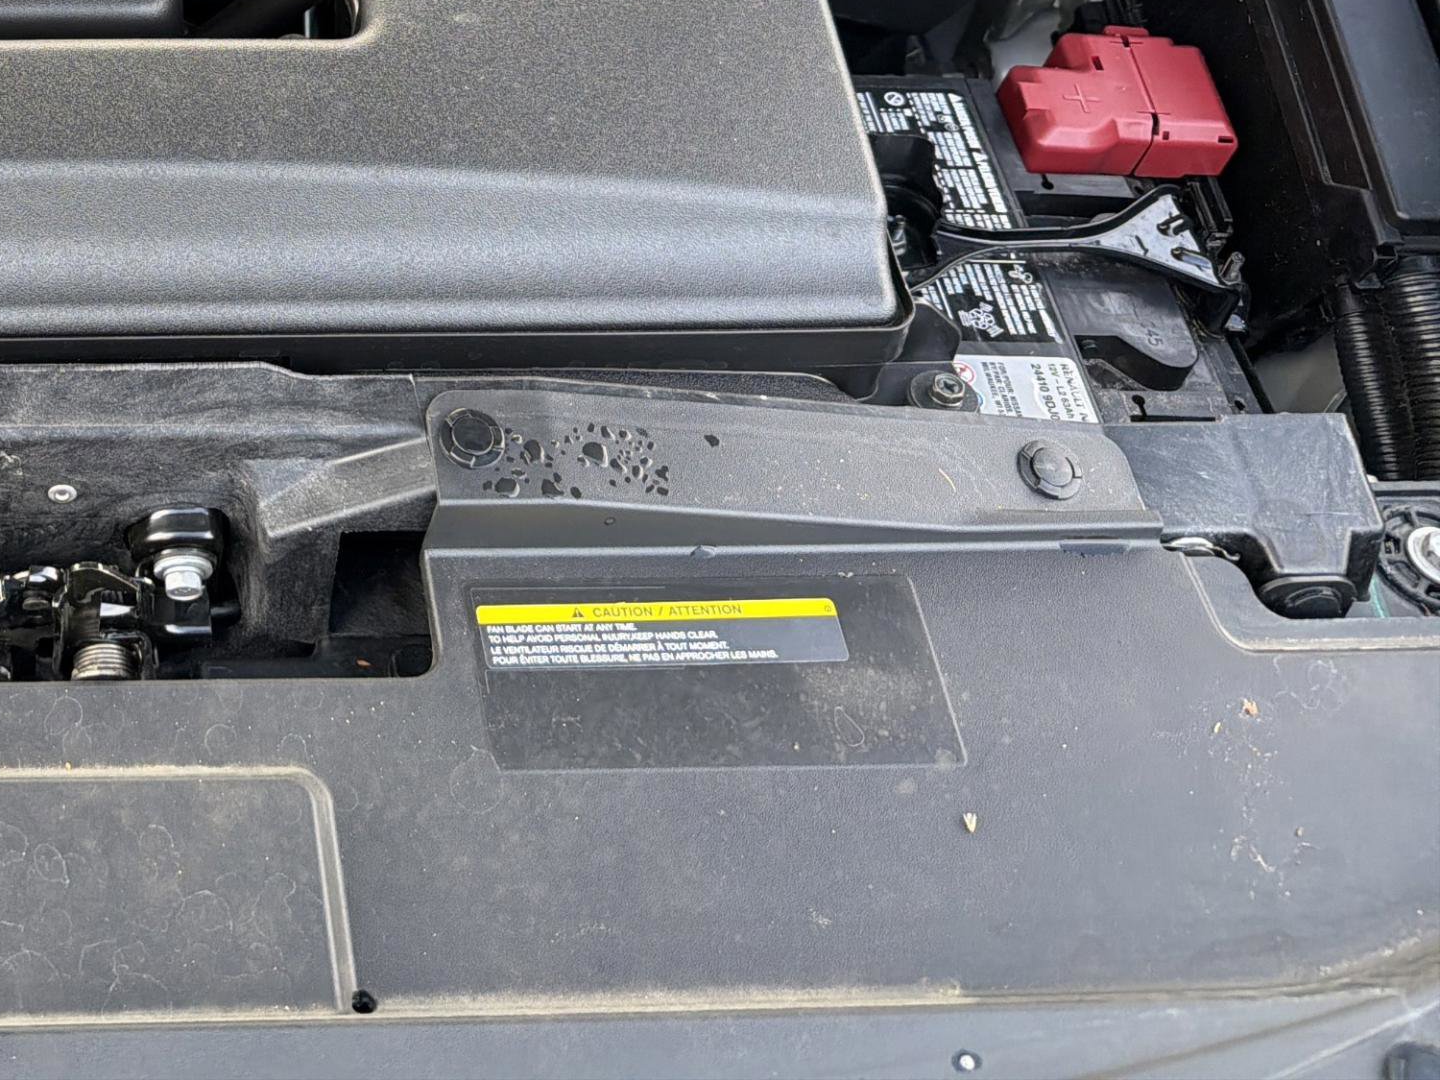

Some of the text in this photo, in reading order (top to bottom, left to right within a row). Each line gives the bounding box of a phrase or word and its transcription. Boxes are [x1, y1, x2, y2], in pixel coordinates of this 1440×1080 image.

[1030, 363, 1050, 393] 24410
[592, 607, 653, 618] CAUTION
[669, 605, 743, 617] ATTENTION
[487, 622, 638, 633] FAN BLADE CAN START AT ANY TIME.
[488, 635, 501, 644] TO
[502, 634, 525, 643] HELP
[526, 634, 553, 643] AVOID
[554, 633, 602, 642] PERSONAL
[655, 631, 686, 640] HANDS
[687, 630, 718, 639] CLEAR.
[490, 640, 730, 655] LE VENTILATEUR RISQUE DE DÉMARRER À TOUT MOMENT.
[492, 656, 518, 665] POUR
[520, 654, 549, 664] ÉVITER
[550, 655, 579, 664] TOUTE
[628, 653, 642, 662] NE
[642, 653, 661, 661] PAS
[661, 652, 675, 661] EN
[675, 651, 730, 660] APPROCHER
[731, 650, 748, 659] LES
[748, 649, 779, 658] MAINS.
